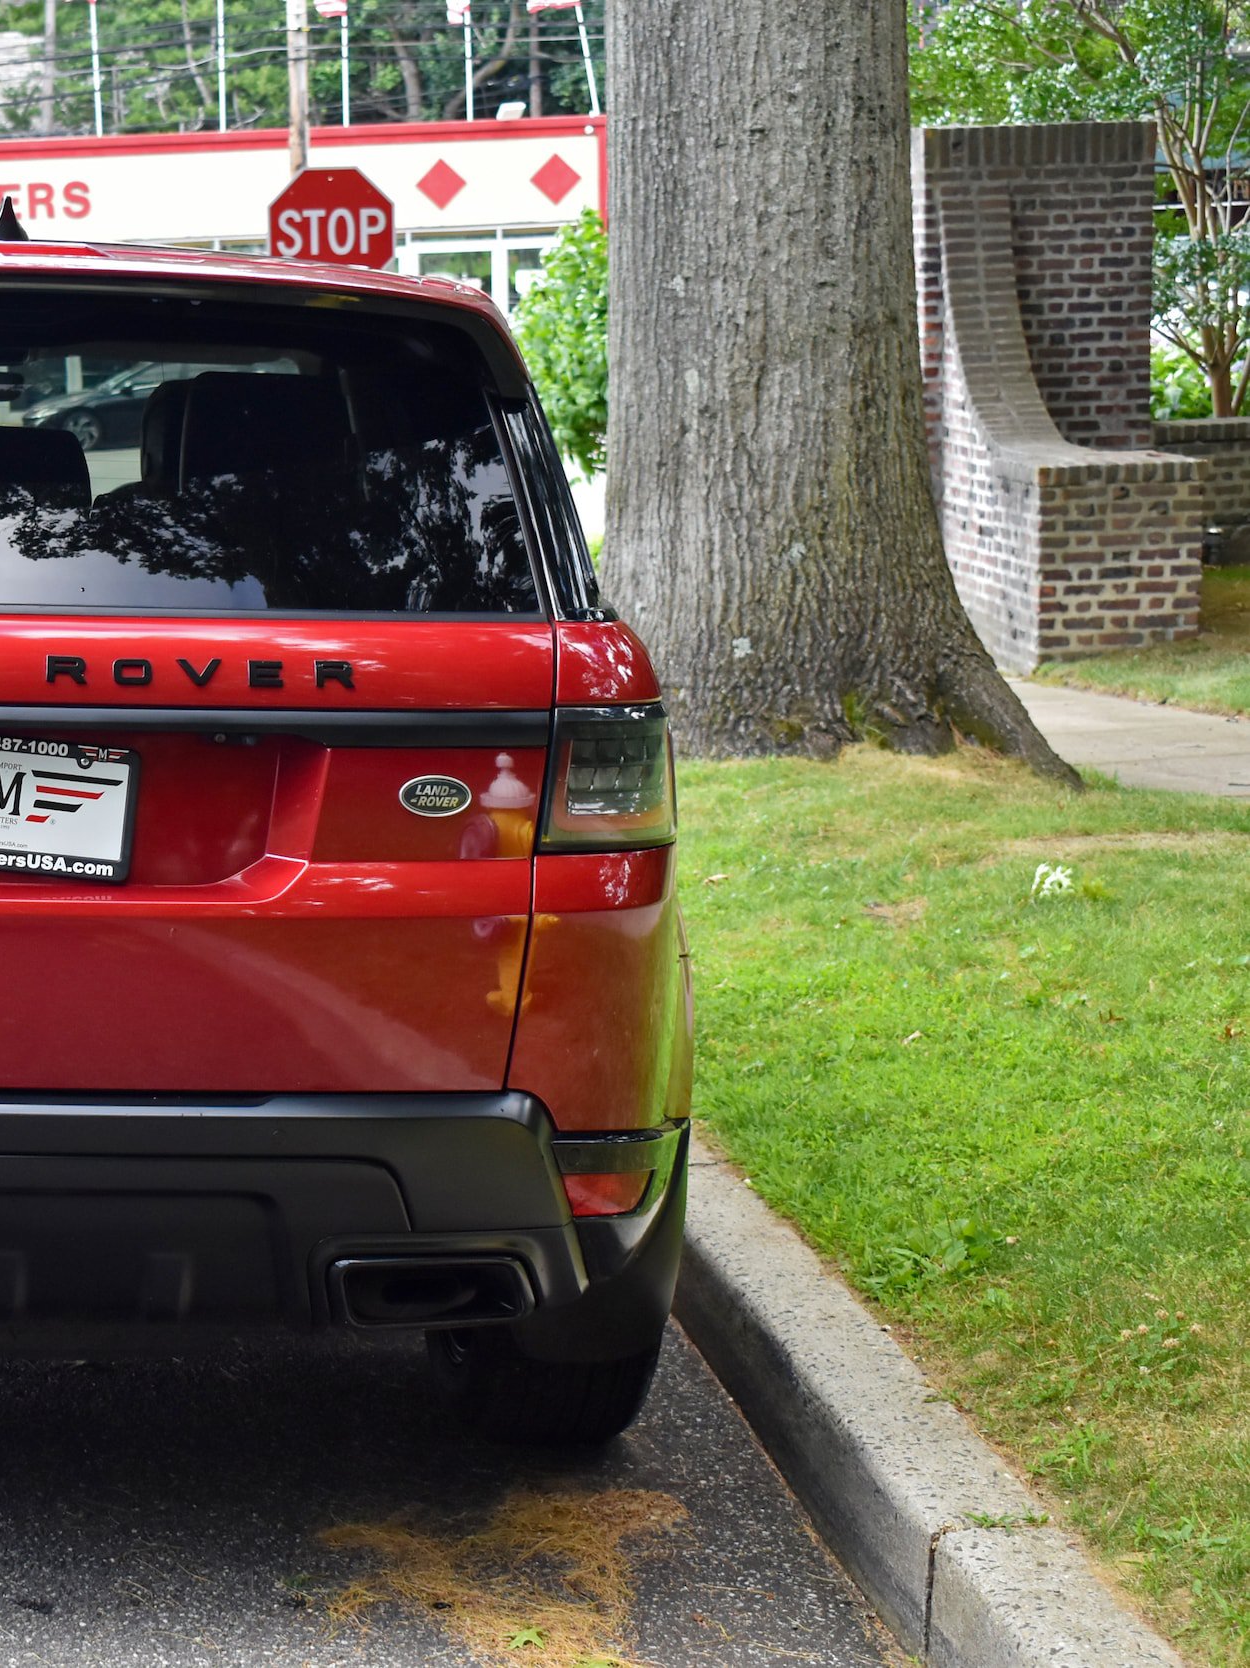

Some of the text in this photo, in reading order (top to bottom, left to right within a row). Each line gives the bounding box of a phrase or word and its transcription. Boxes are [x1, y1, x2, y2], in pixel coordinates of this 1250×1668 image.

[276, 207, 387, 257] STOP
[45, 654, 355, 689] ROVER
[98, 748, 108, 760] M
[415, 784, 450, 797] LAND
[417, 796, 459, 808] ROVER
